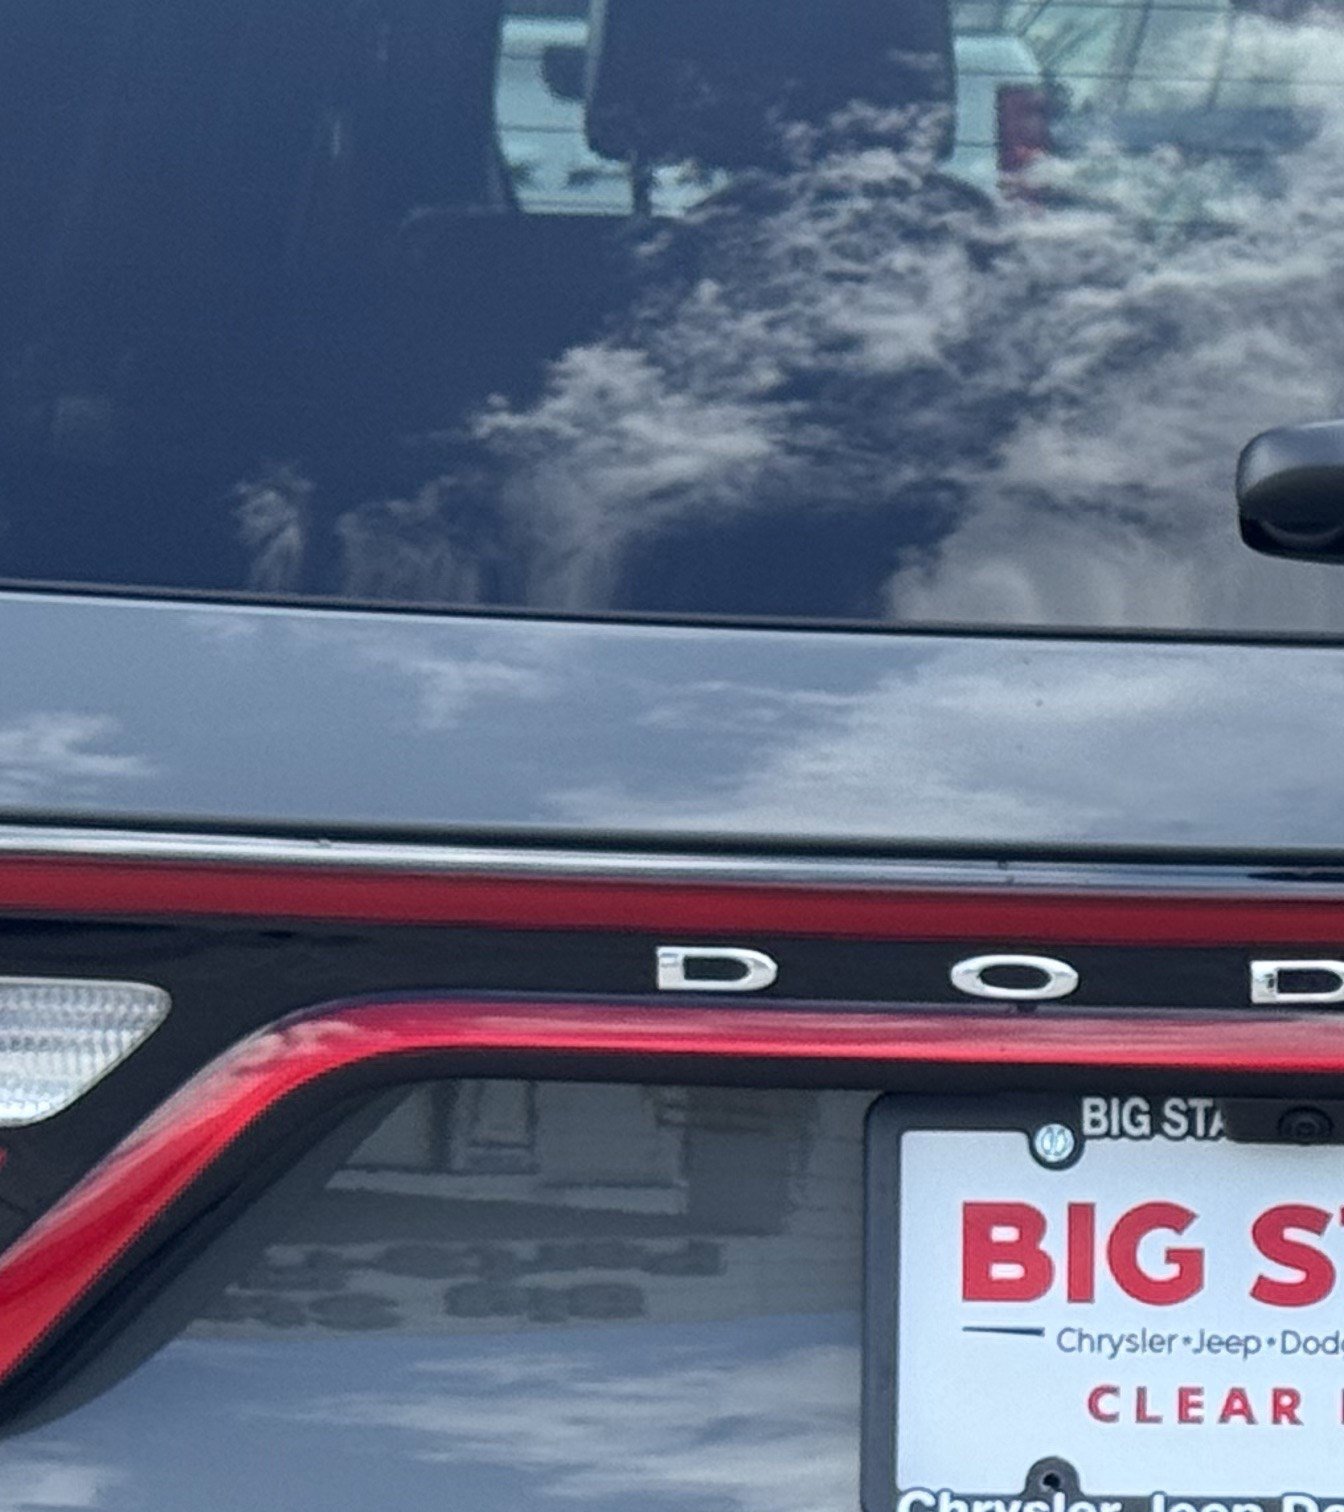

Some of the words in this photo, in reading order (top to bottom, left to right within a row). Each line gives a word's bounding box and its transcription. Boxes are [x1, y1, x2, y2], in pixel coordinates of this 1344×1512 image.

[1082, 1096, 1150, 1137] BIG
[961, 1202, 1205, 1305] BIG
[1056, 1327, 1179, 1359] Chrysler
[1193, 1330, 1262, 1360] Jeep
[1087, 1385, 1304, 1426] CLEAR
